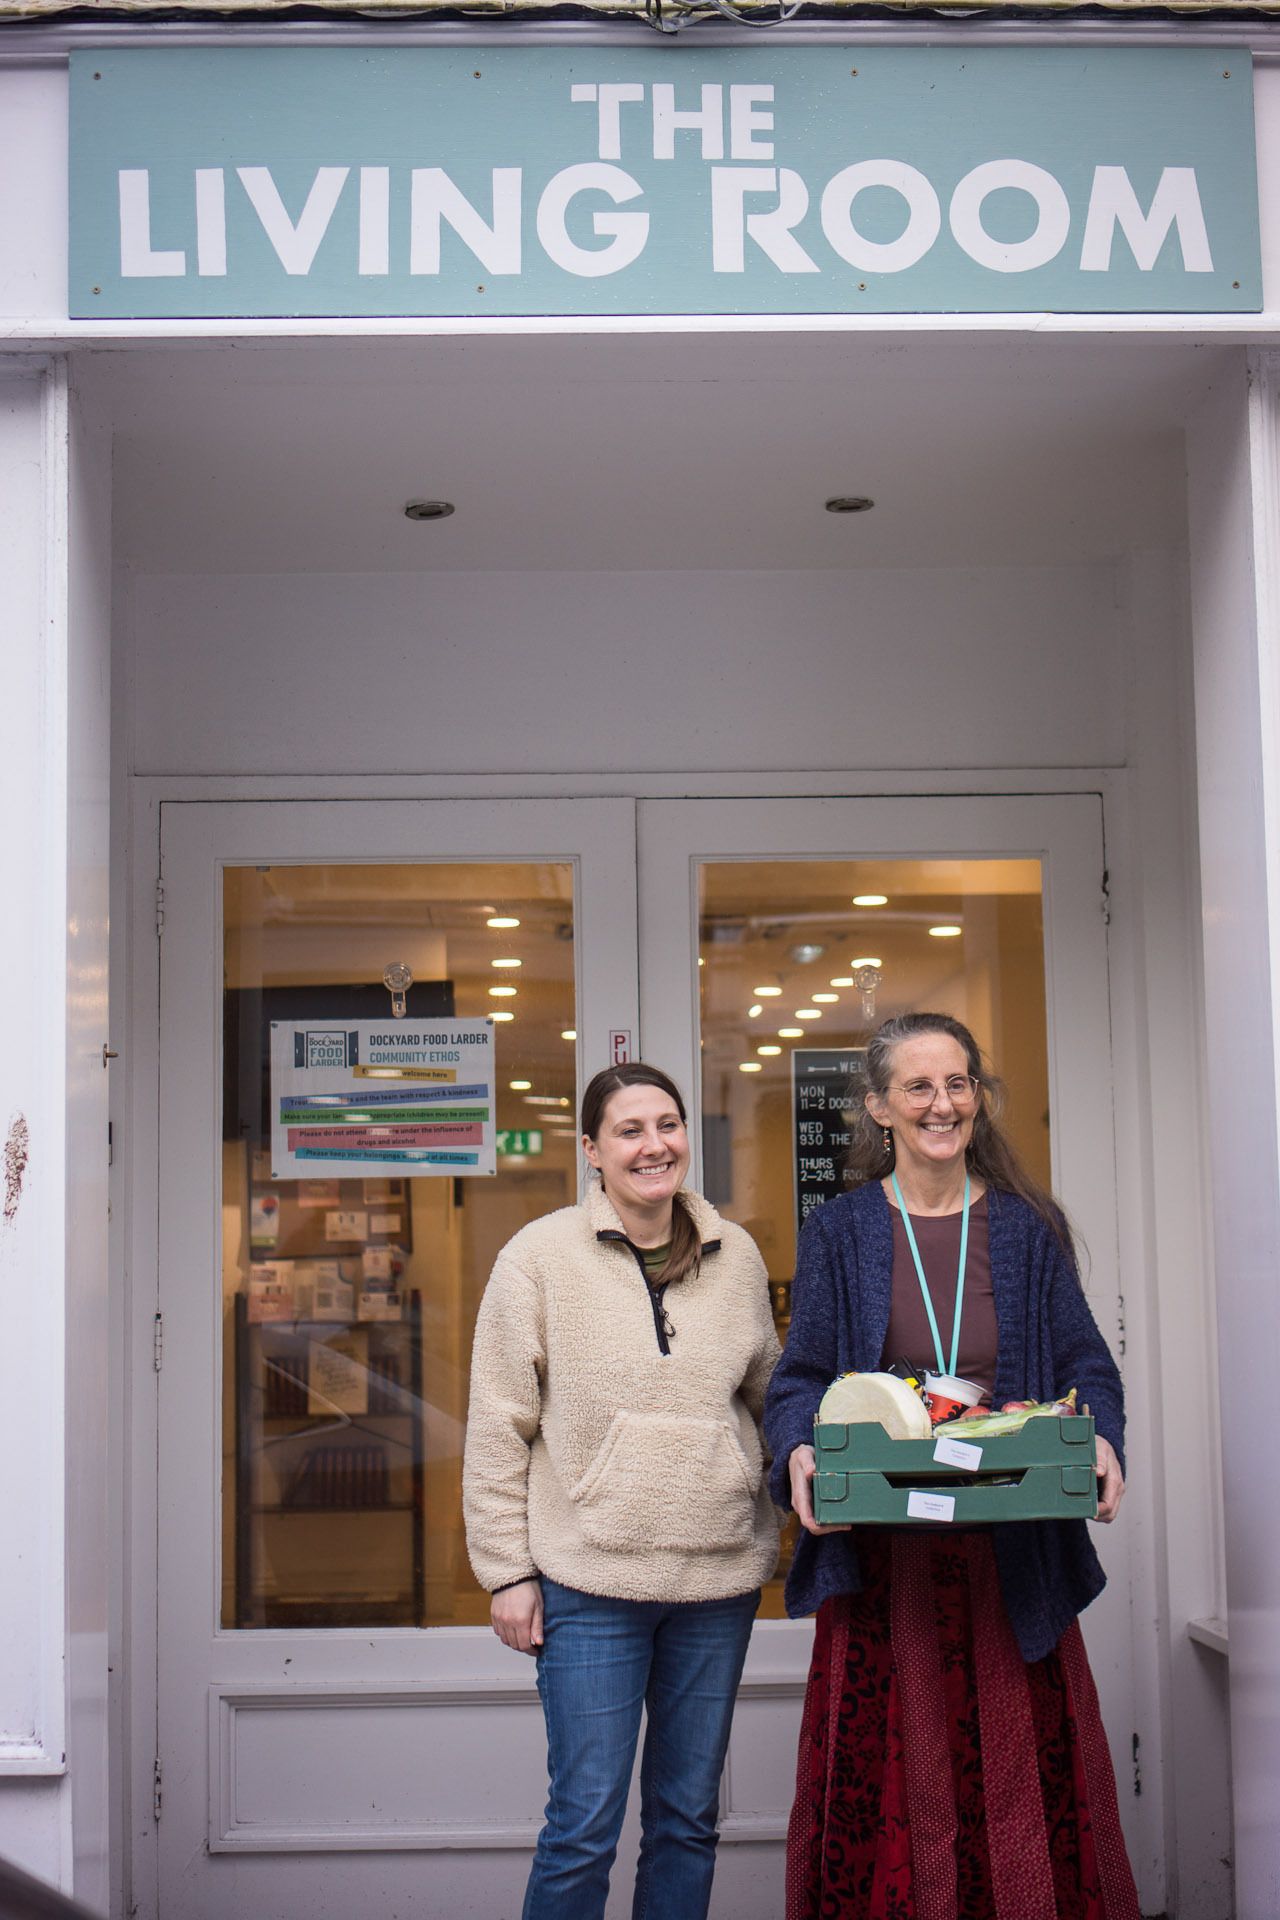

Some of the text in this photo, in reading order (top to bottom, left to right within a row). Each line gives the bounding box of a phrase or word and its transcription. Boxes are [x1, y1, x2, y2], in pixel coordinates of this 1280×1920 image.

[571, 83, 775, 161] THE
[117, 158, 1214, 278] LIVING ROOM
[369, 1033, 488, 1046] DOCKYARD FOOD LARDER
[310, 1047, 343, 1058] FOOD
[614, 1035, 627, 1065] PU
[369, 1051, 460, 1063] COMMUNITY ETHOS
[310, 1059, 343, 1067] LARDER
[402, 1070, 431, 1078] welcome
[432, 1071, 448, 1079] here
[415, 1090, 440, 1099] respect
[448, 1088, 479, 1096] kindness
[800, 1086, 825, 1097] MON
[801, 1098, 825, 1109] 11-2
[369, 1112, 405, 1120] ppropriate
[406, 1111, 434, 1119] (children
[459, 1110, 485, 1119] present)
[433, 1125, 464, 1133] influence
[799, 1121, 824, 1133] WED
[356, 1139, 375, 1147] drugs
[800, 1134, 824, 1146] 930
[306, 1149, 328, 1157] Please
[329, 1150, 345, 1158] keep
[363, 1150, 400, 1160] belongings
[799, 1157, 834, 1169] THURS
[800, 1169, 836, 1181] 2-245
[801, 1193, 825, 1205] SUN
